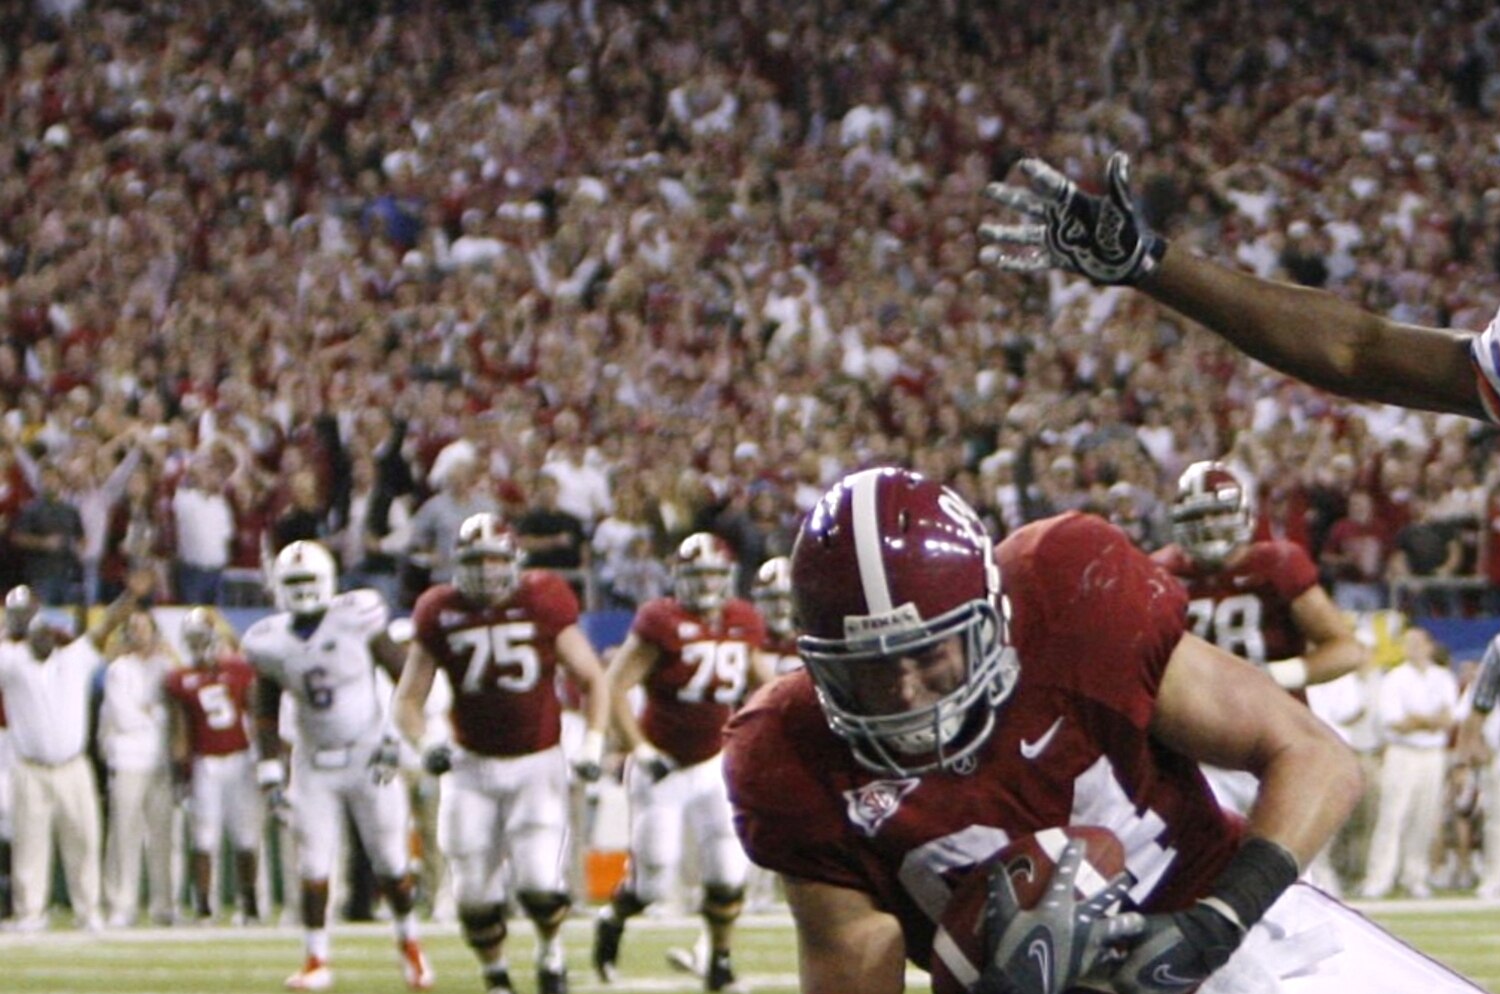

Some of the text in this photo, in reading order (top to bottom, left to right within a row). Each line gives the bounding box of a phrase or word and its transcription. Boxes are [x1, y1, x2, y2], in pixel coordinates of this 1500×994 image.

[446, 620, 541, 695] 75
[1185, 592, 1270, 668] 78
[301, 664, 336, 713] 6
[676, 640, 748, 704] 79
[197, 683, 238, 731] 5
